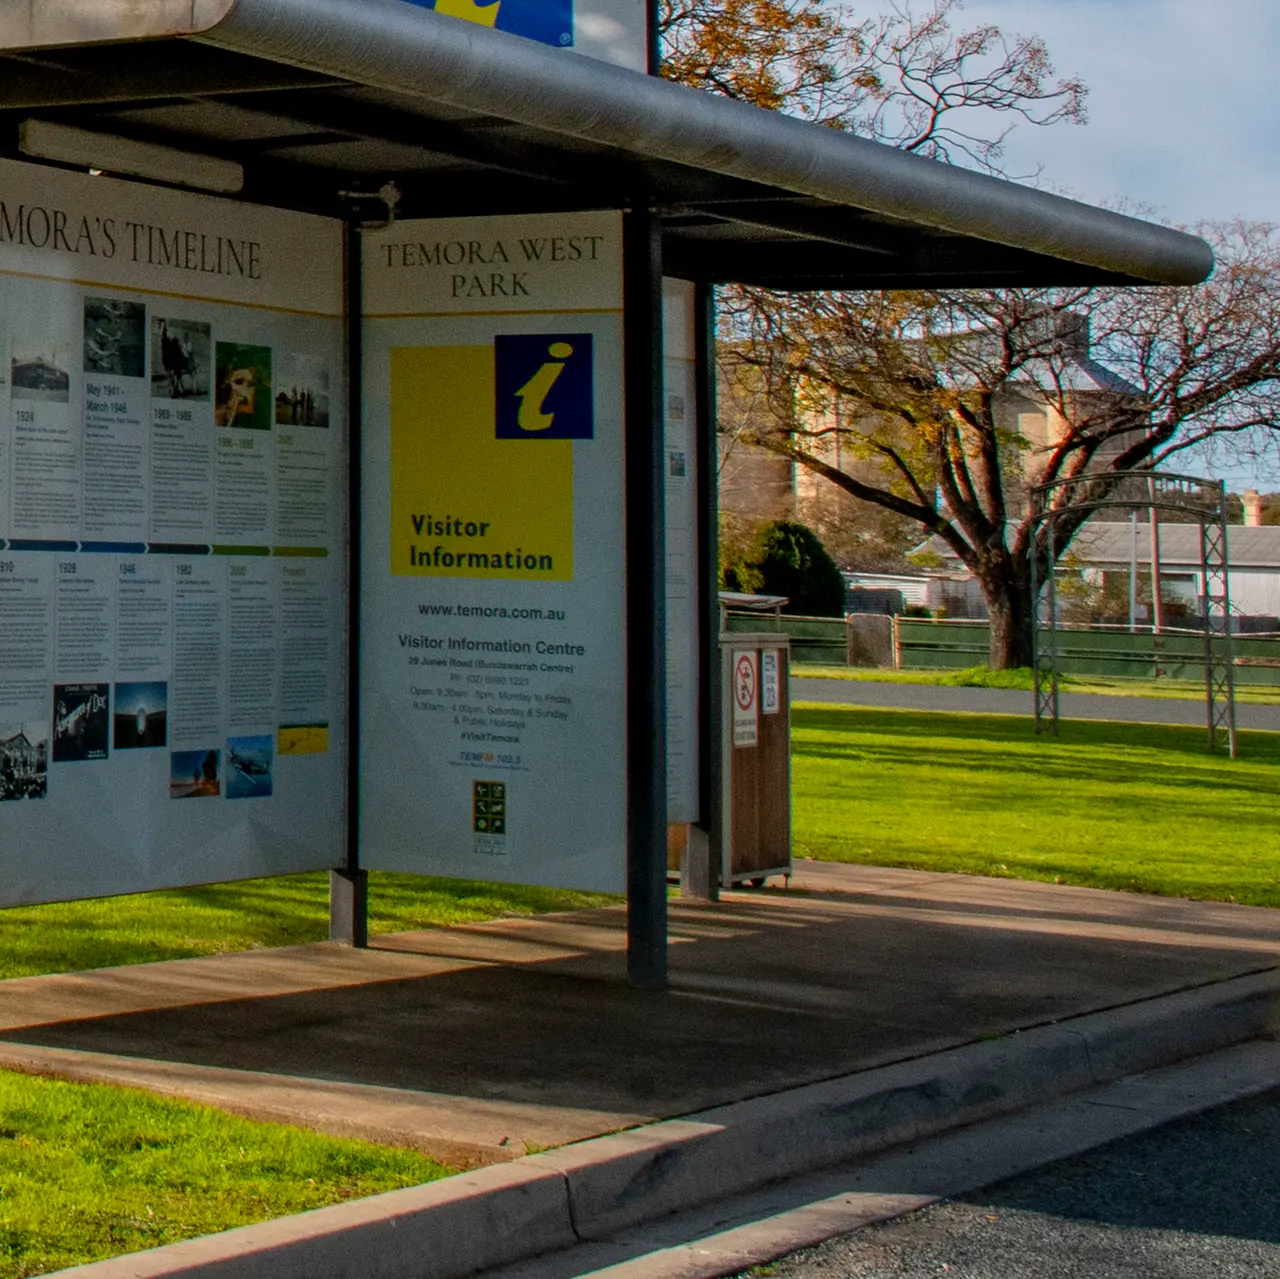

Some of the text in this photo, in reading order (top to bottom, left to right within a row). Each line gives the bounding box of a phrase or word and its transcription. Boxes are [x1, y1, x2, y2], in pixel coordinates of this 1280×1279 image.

[126, 222, 262, 280] TIMELINE
[381, 235, 604, 268] TEMORA WEST
[450, 271, 530, 298] PARK
[86, 400, 109, 413] March
[411, 514, 490, 538] Visitor
[410, 544, 553, 571] Information
[419, 604, 565, 621] www.temora.com.au
[398, 634, 585, 656] Visitor Information Centre
[449, 658, 473, 668] Road
[540, 663, 574, 674] Centre)
[498, 691, 532, 703] Monday
[534, 693, 543, 702] to
[544, 694, 571, 705] Friday
[486, 705, 524, 718] Saturday
[535, 709, 569, 721] Sunday
[462, 716, 488, 726] Public
[489, 718, 526, 730] Holidays
